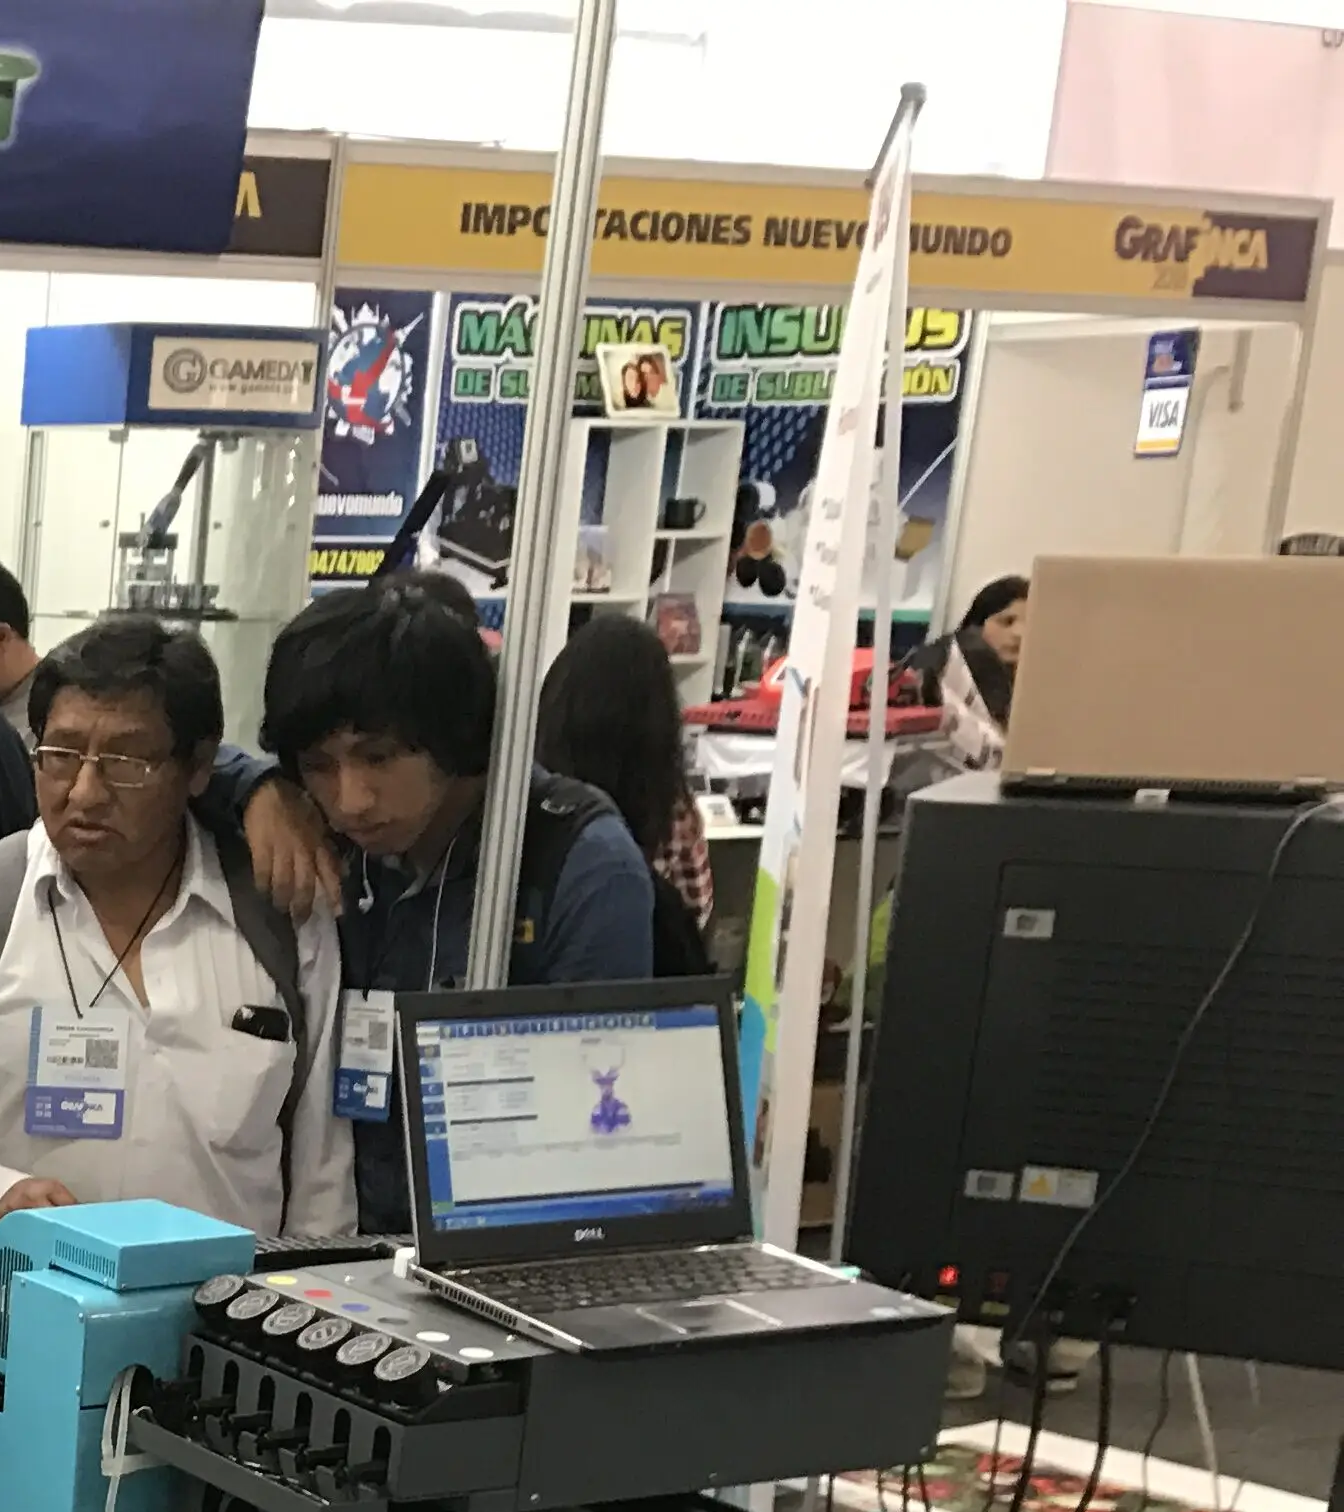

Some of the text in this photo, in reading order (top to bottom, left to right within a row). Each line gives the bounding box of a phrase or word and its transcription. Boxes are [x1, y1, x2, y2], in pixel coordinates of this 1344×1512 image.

[460, 202, 752, 246] IMPOTACIONES
[459, 302, 687, 358] MÁINAS
[717, 306, 960, 358] INSUS
[714, 364, 955, 401] DE SUBLIÓN
[1148, 400, 1179, 428] VISA
